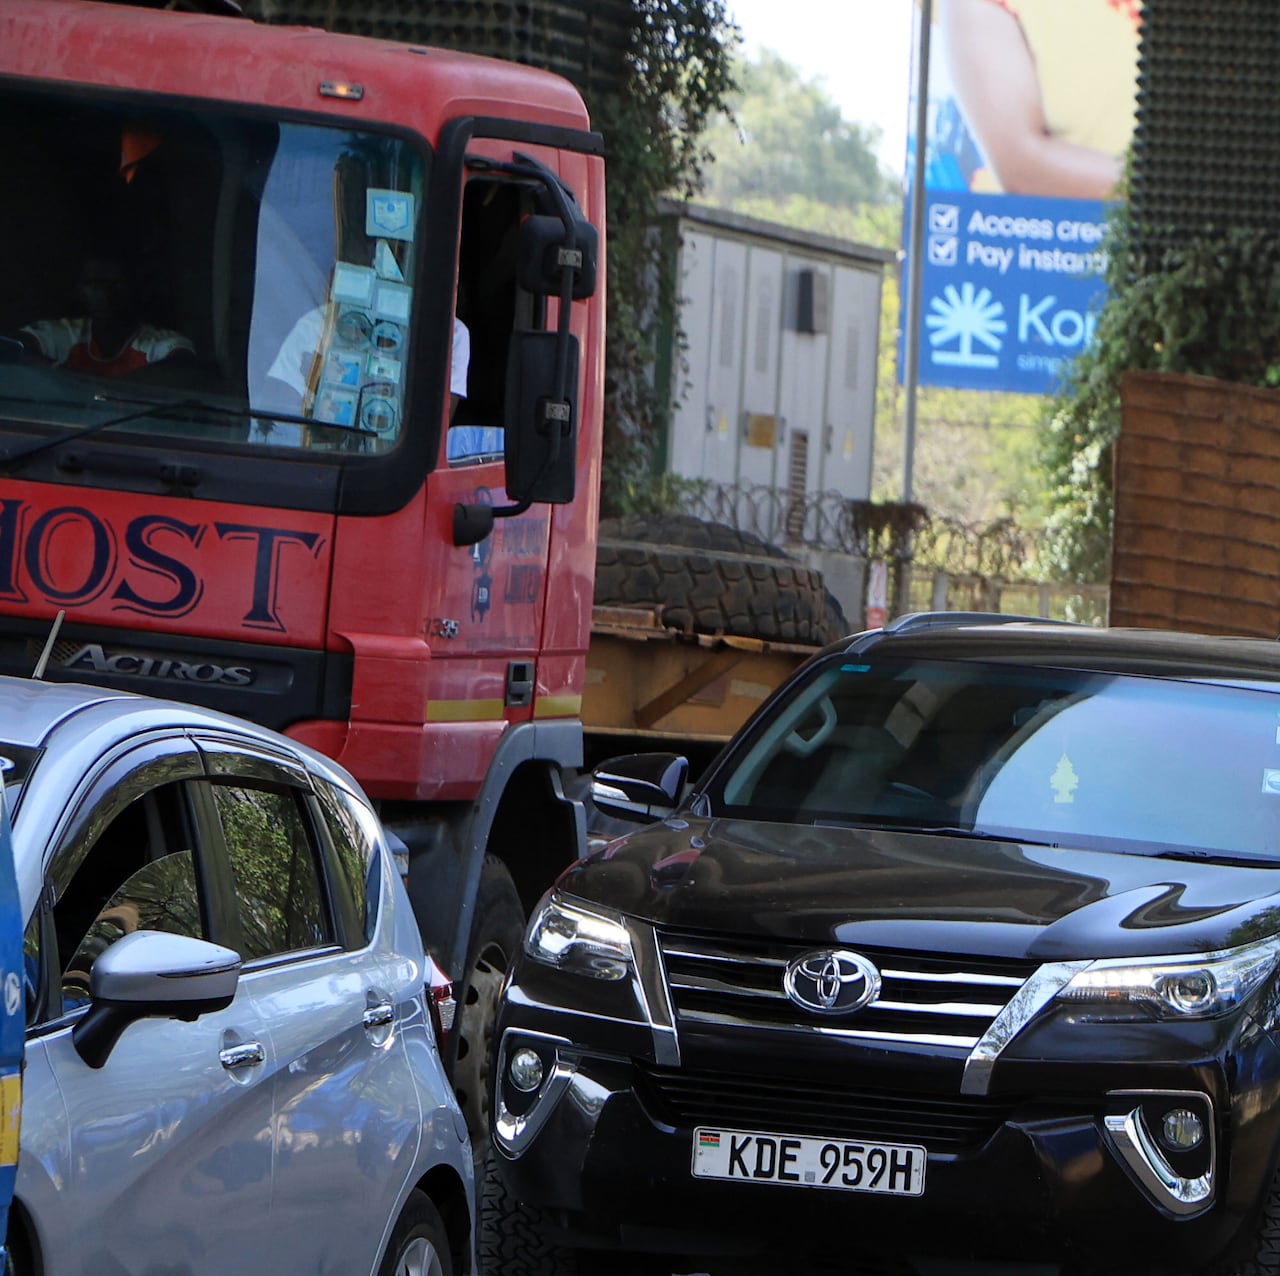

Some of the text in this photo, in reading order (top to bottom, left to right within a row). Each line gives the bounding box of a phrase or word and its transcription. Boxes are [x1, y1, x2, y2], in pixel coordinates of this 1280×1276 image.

[967, 210, 1054, 241] Access
[966, 240, 1014, 275] Pay
[728, 1134, 914, 1192] KDE 959H
